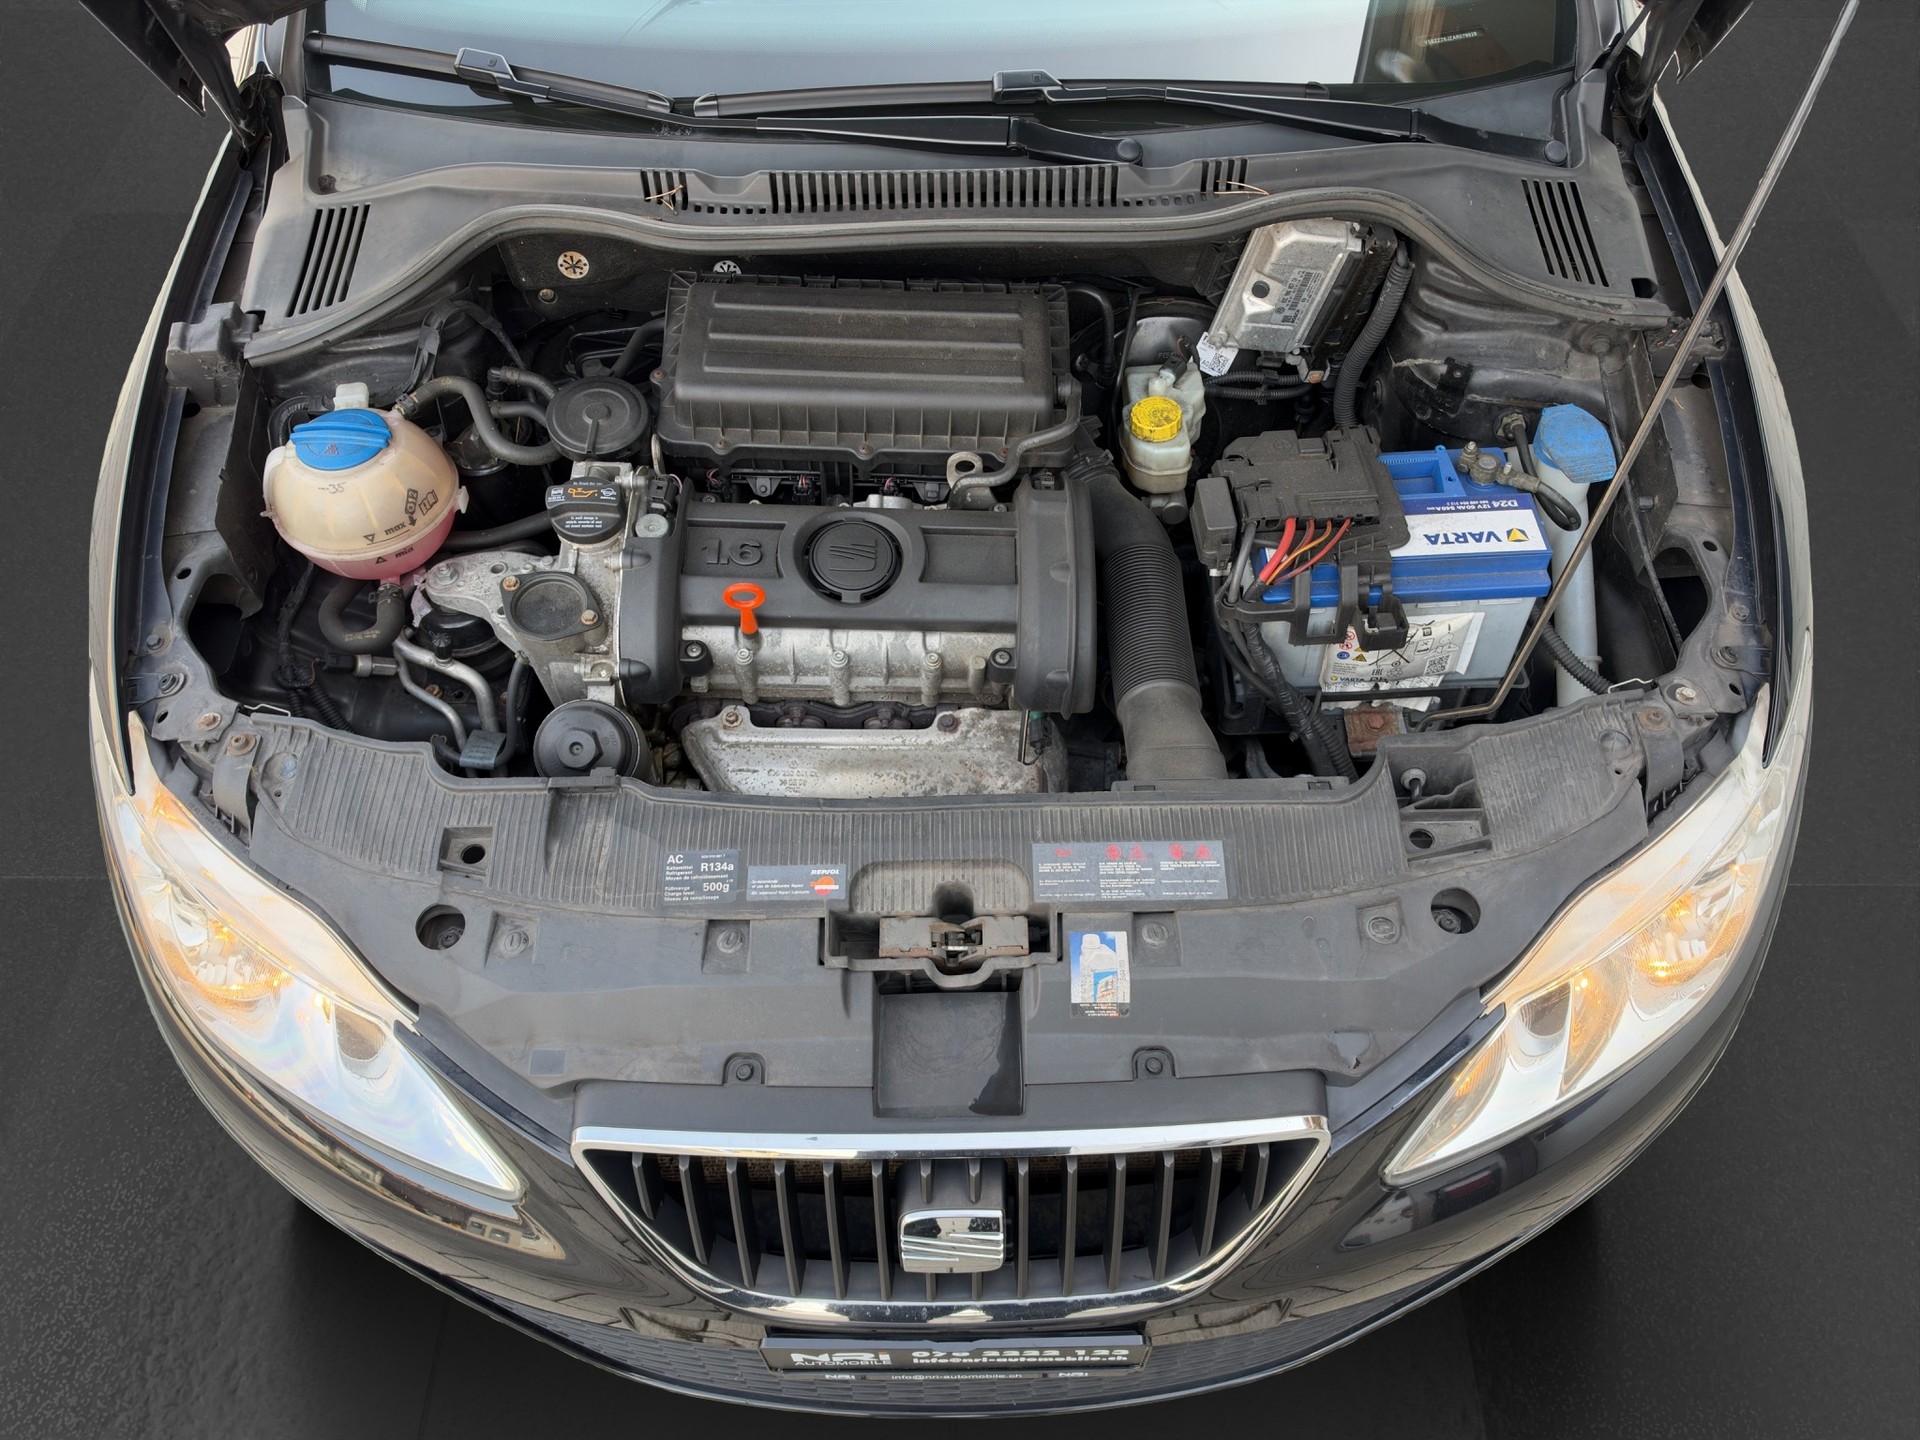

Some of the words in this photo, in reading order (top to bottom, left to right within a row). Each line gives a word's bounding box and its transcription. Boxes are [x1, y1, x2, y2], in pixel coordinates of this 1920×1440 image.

[1491, 499, 1519, 508] D24
[384, 522, 406, 536] max
[1423, 531, 1503, 545] VARTA
[395, 546, 414, 558] min
[701, 538, 763, 566] 1.6
[667, 854, 684, 864] AC
[700, 862, 734, 872] R134a
[702, 882, 730, 893] 500g
[981, 1349, 1060, 1357] 2222
[912, 1355, 1128, 1364] info@nri-automobile.ch
